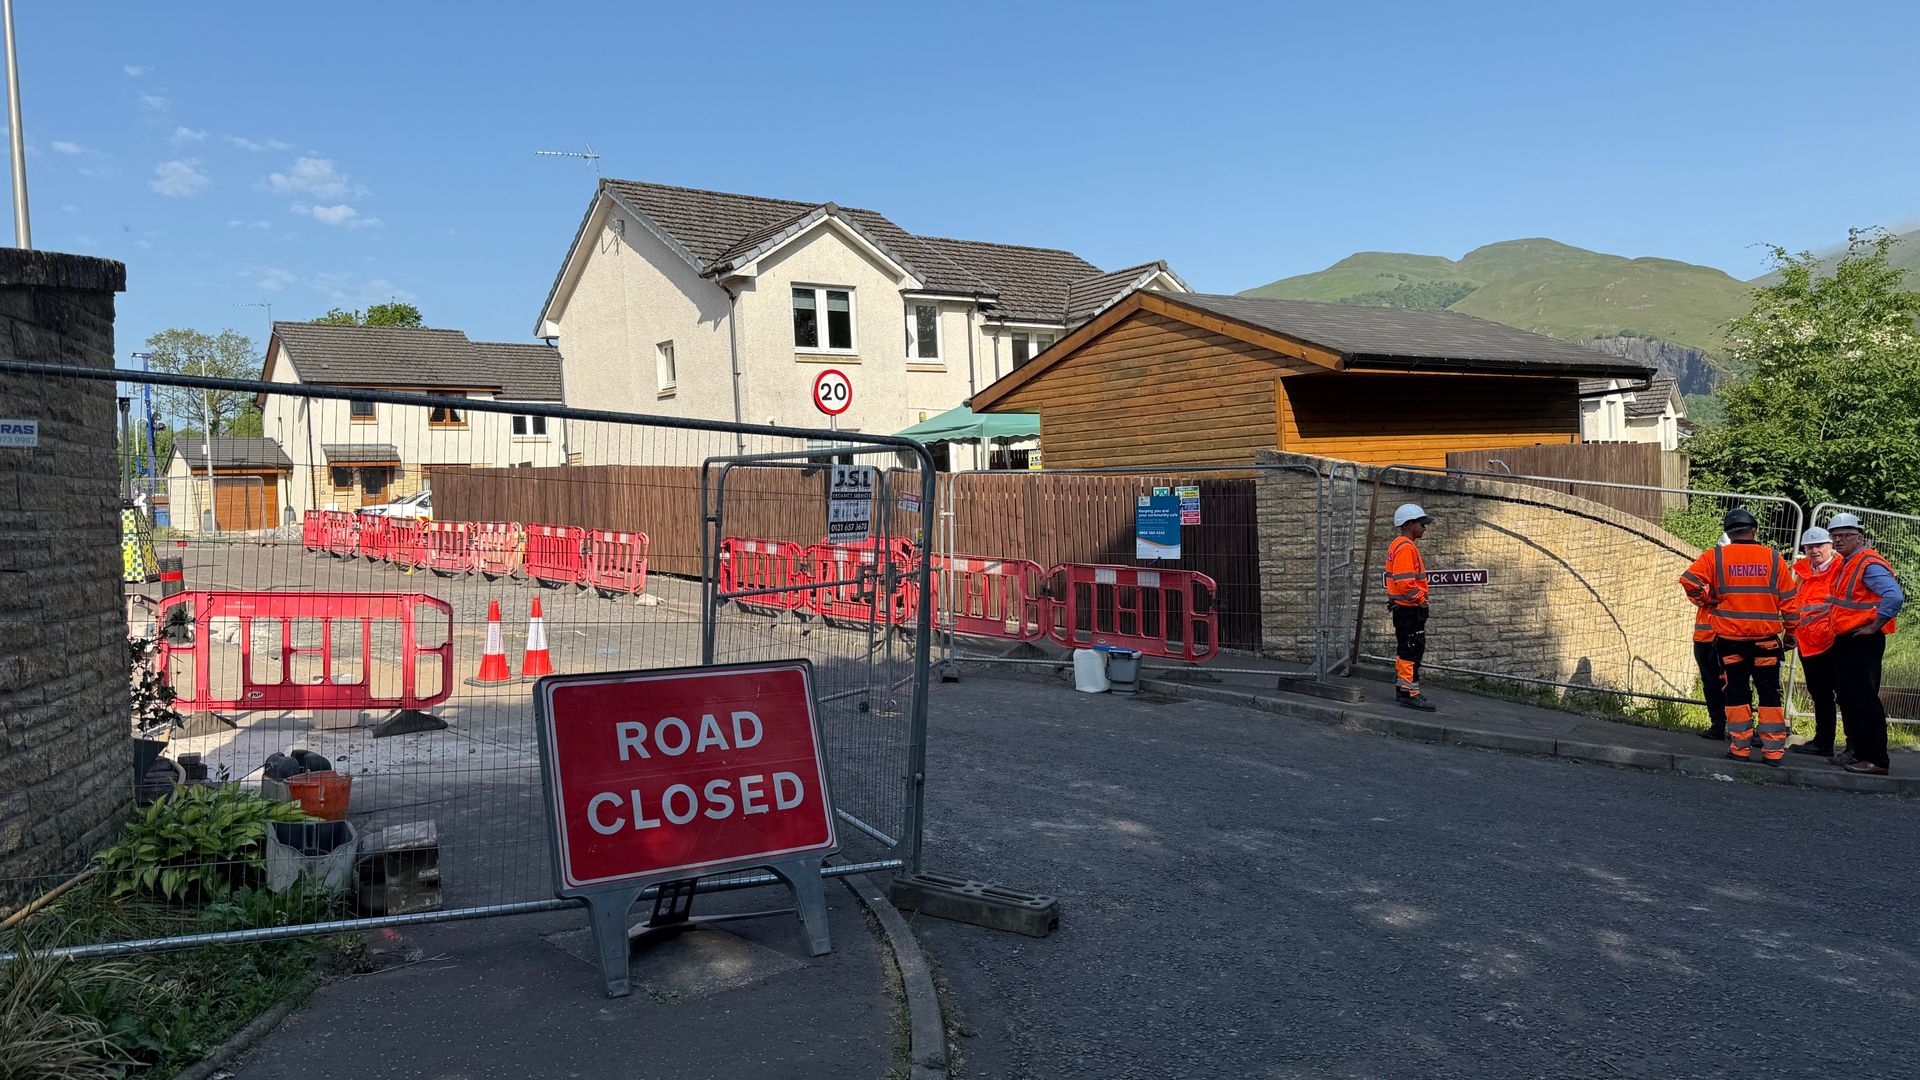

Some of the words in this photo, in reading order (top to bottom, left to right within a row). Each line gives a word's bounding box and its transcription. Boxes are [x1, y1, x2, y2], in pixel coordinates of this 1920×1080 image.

[820, 383, 847, 401] 20
[0, 424, 34, 434] RAS
[1426, 573, 1448, 583] UCK
[1453, 572, 1482, 583] VIEW
[1728, 564, 1768, 577] MENZIES
[615, 710, 763, 762] ROAD
[587, 771, 805, 836] CLOSED
